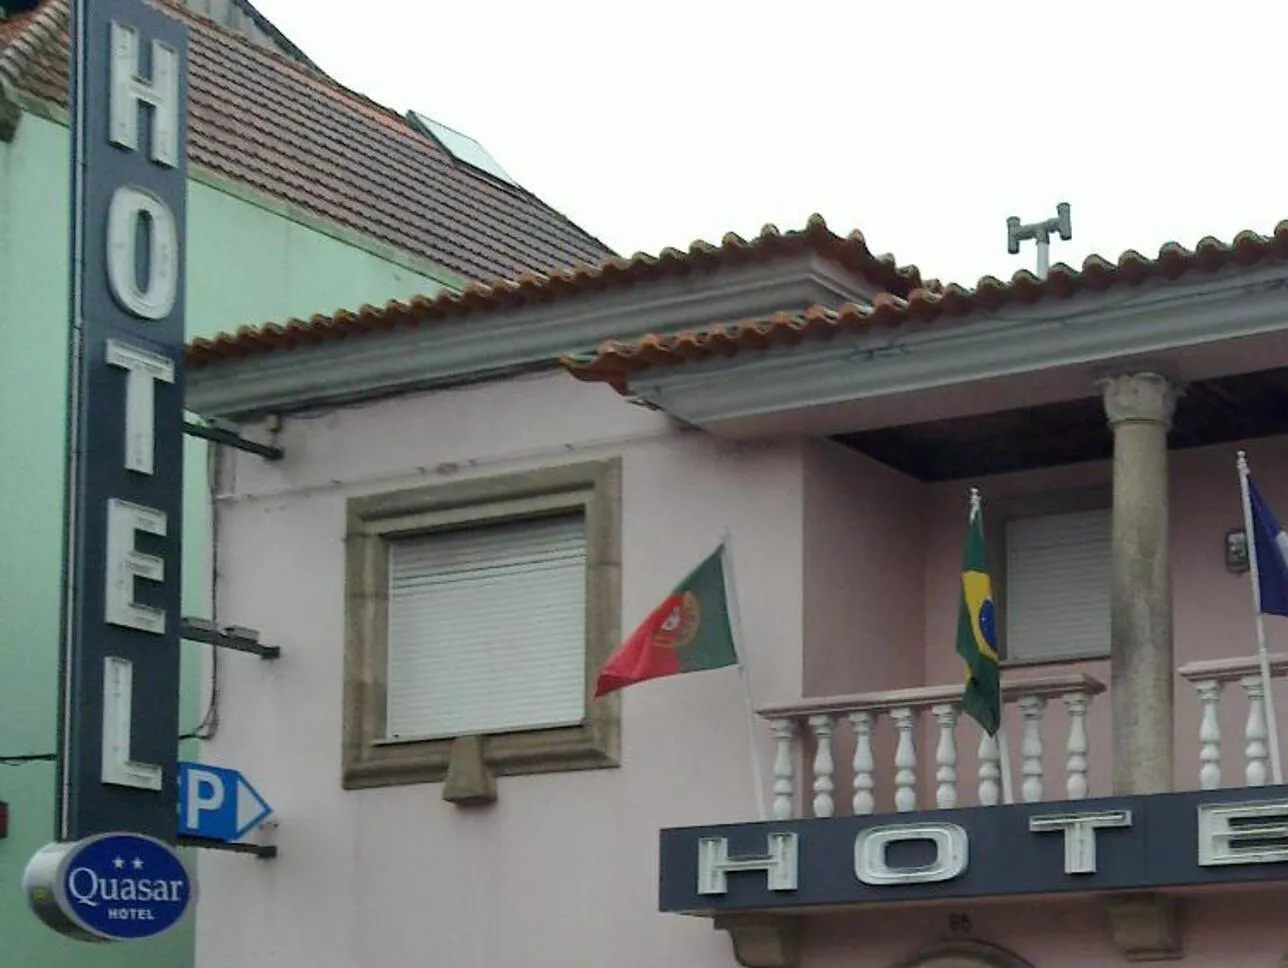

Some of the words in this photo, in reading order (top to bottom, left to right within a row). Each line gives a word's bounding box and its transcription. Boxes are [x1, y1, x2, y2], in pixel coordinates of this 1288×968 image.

[101, 20, 179, 791] HOTEL
[186, 768, 226, 830] P
[68, 866, 185, 907] Quasar
[107, 907, 156, 921] HOTEL
